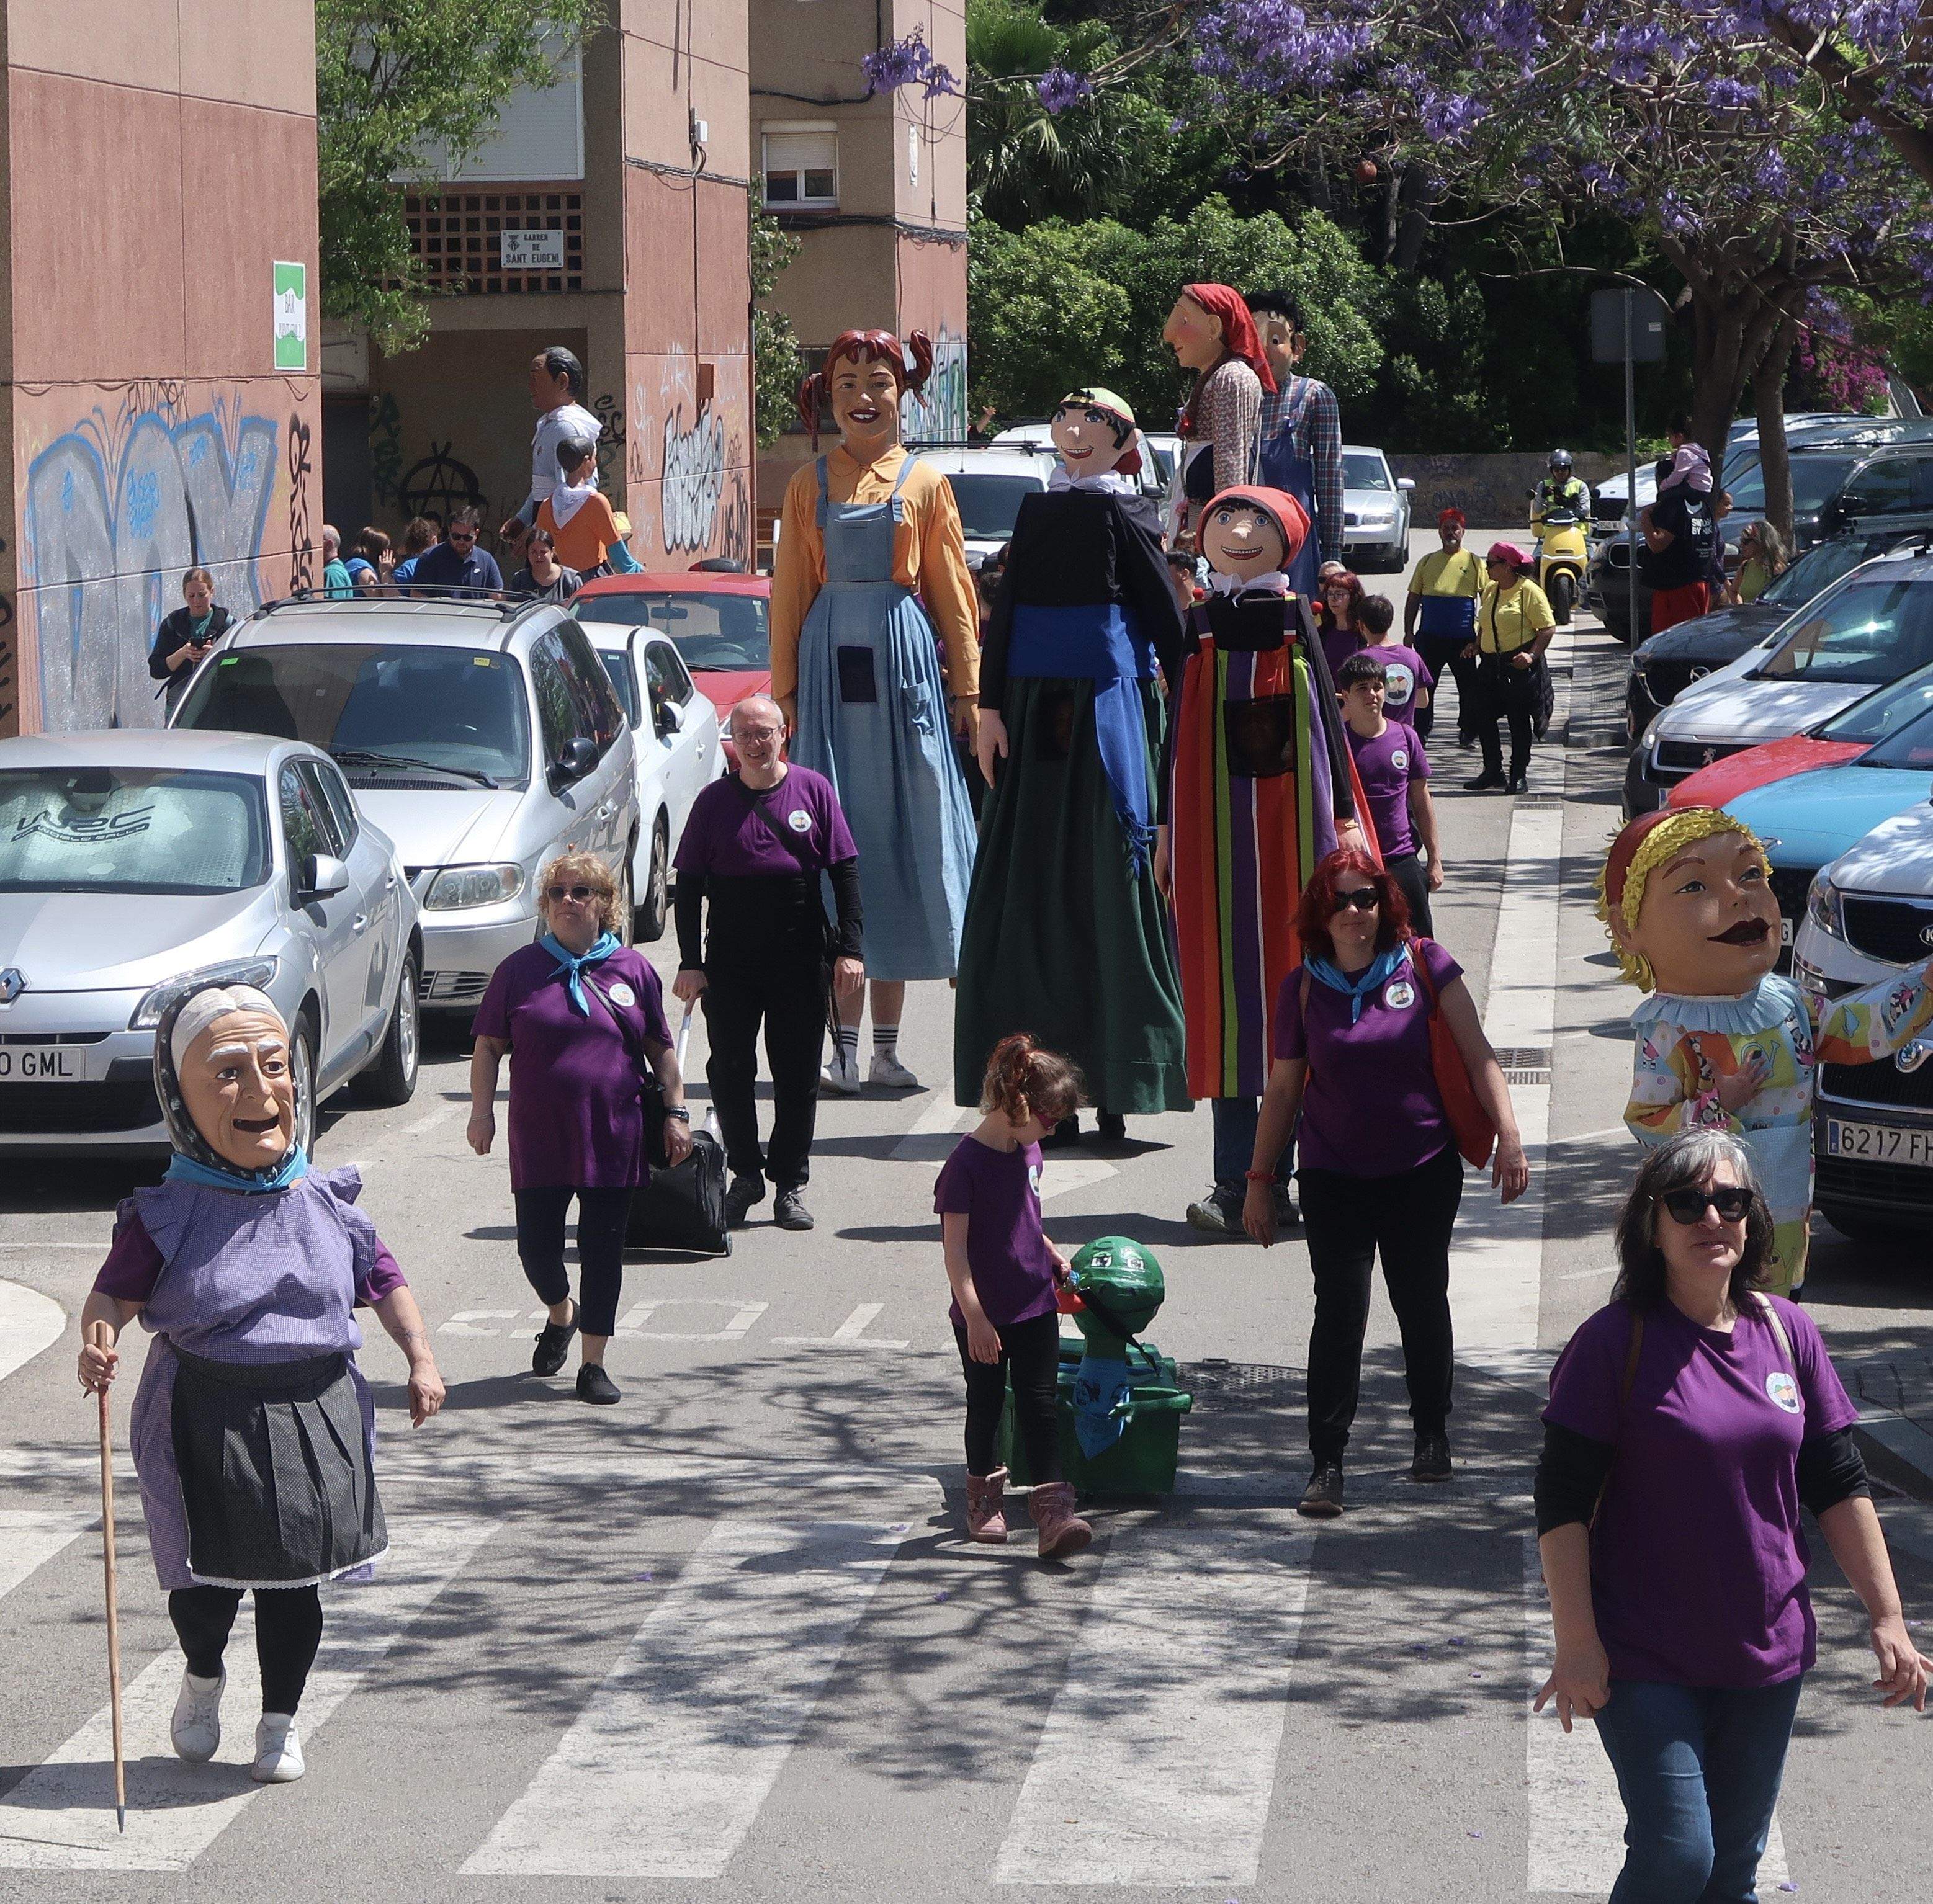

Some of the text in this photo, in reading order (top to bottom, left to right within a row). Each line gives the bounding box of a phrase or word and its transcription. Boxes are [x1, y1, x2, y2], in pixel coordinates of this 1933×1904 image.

[506, 253, 559, 263] SANT EUGENI
[22, 1052, 73, 1076] GML
[1842, 1127, 1902, 1157] 6217
